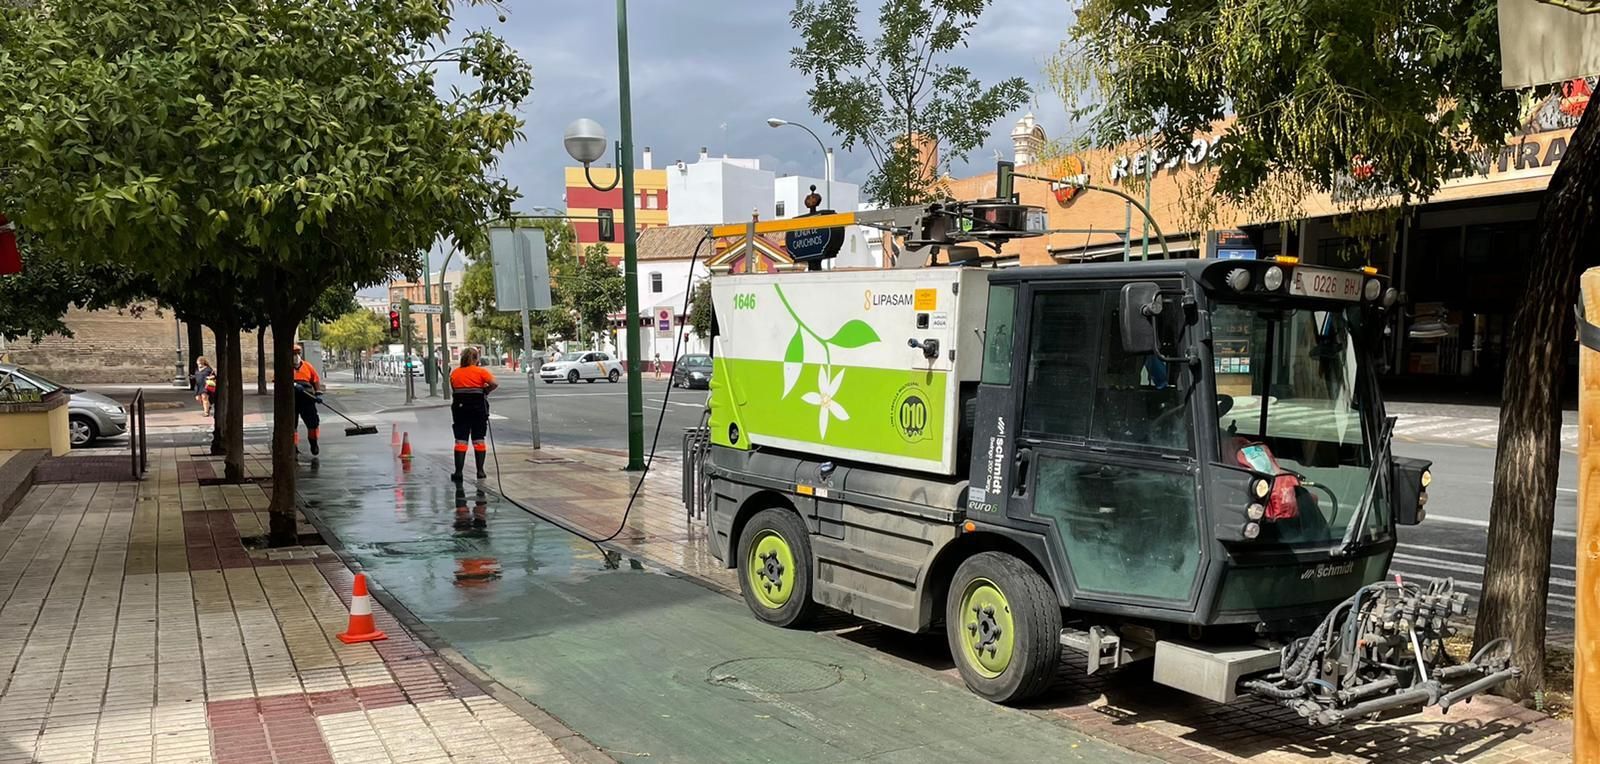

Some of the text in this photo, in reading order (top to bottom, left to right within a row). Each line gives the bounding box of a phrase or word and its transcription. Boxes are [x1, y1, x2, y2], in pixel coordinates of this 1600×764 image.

[792, 235, 823, 250] CAPUCHINOS
[1295, 272, 1361, 296] E 0226 BHJ
[733, 293, 756, 310] 1646
[873, 294, 913, 306] LIPASAM
[902, 403, 924, 429] 010
[992, 437, 1004, 495] schmidt
[1317, 561, 1354, 578] schmidt
